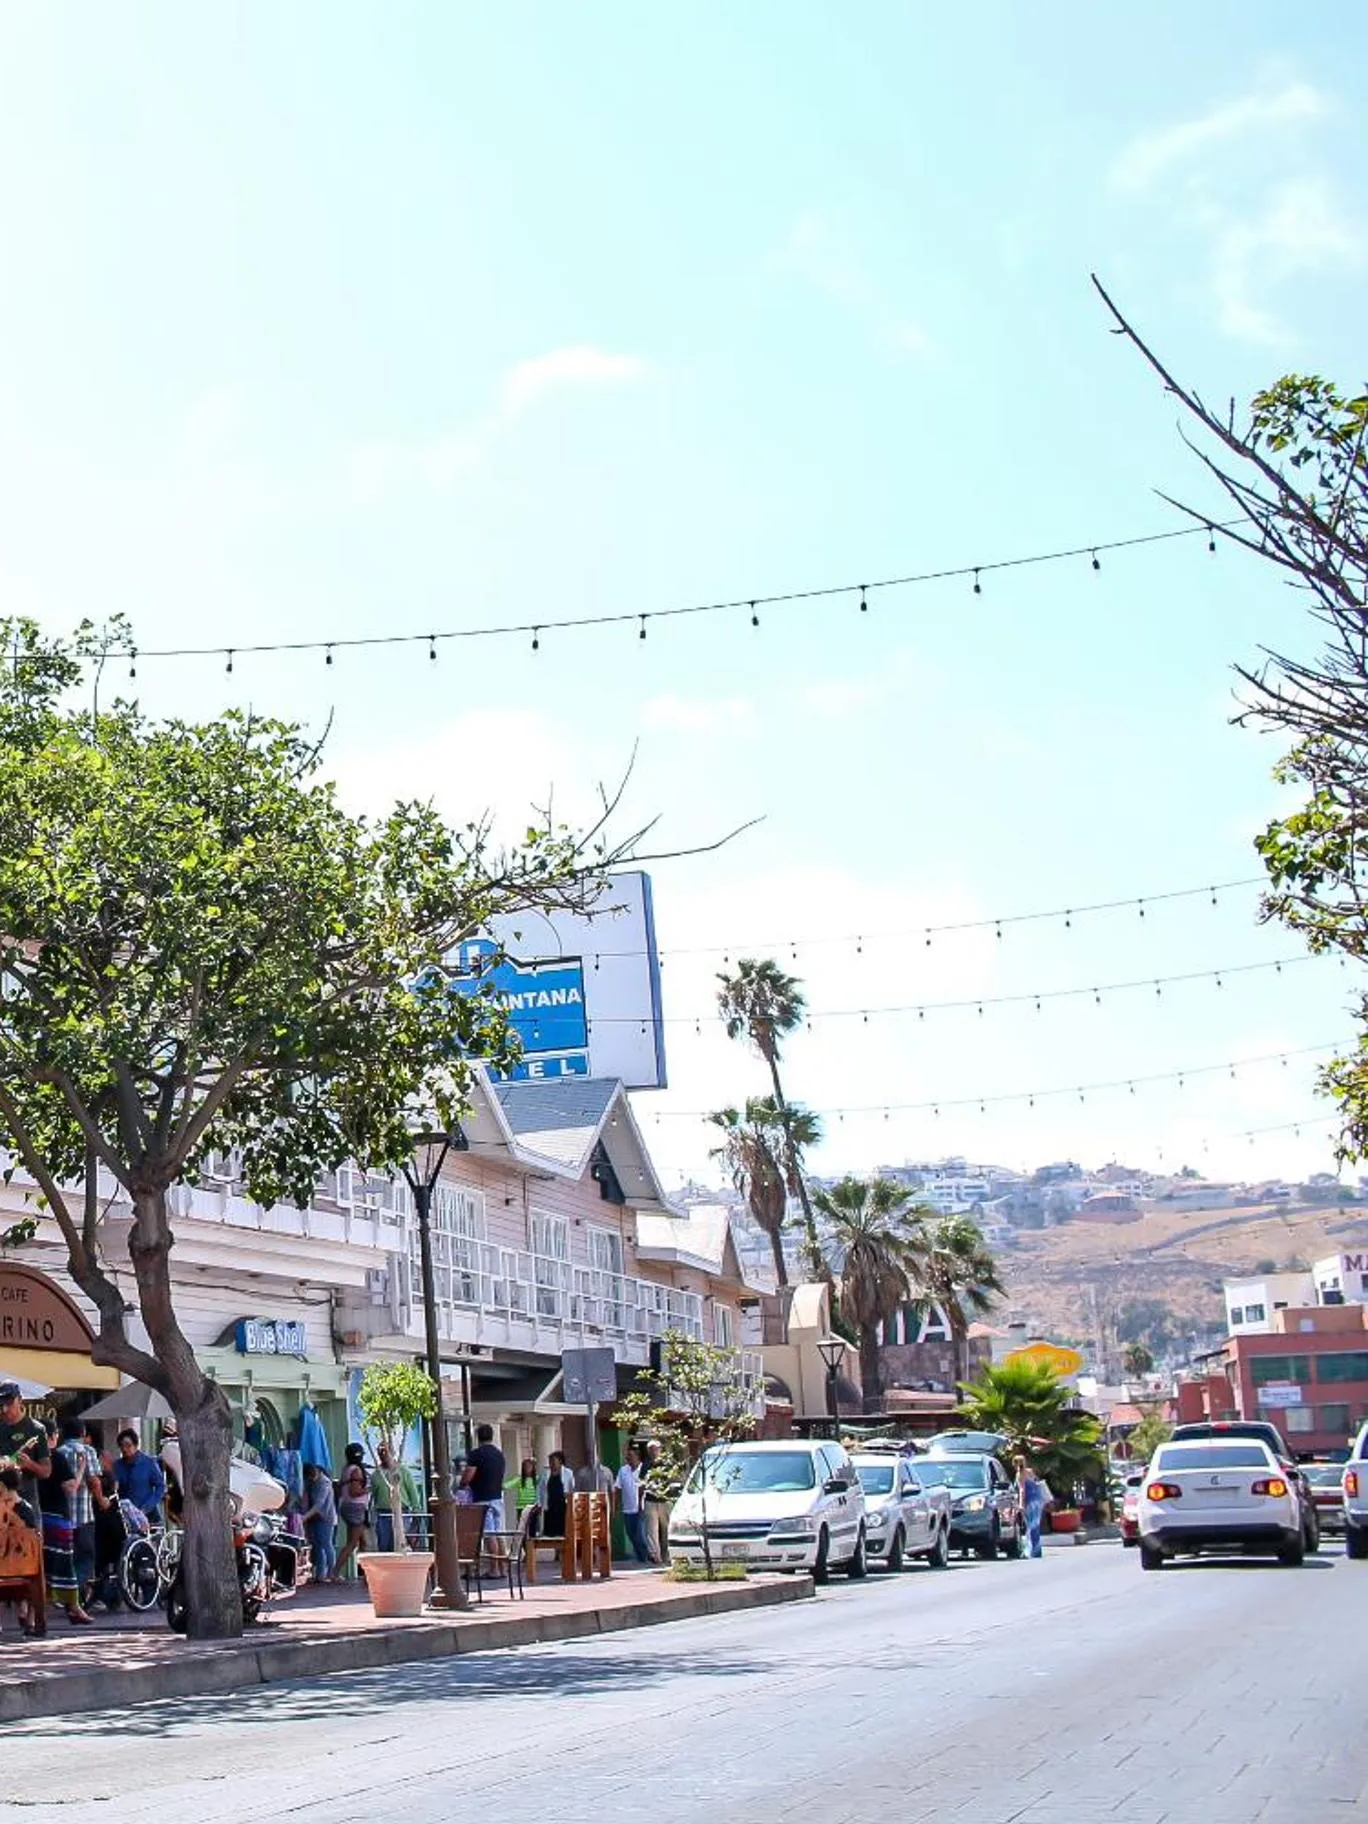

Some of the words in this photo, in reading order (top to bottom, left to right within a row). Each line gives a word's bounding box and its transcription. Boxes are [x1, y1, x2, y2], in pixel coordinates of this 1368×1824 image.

[1, 1287, 29, 1303] CAFE
[245, 1320, 275, 1353] Blue
[276, 1320, 308, 1353] Shell
